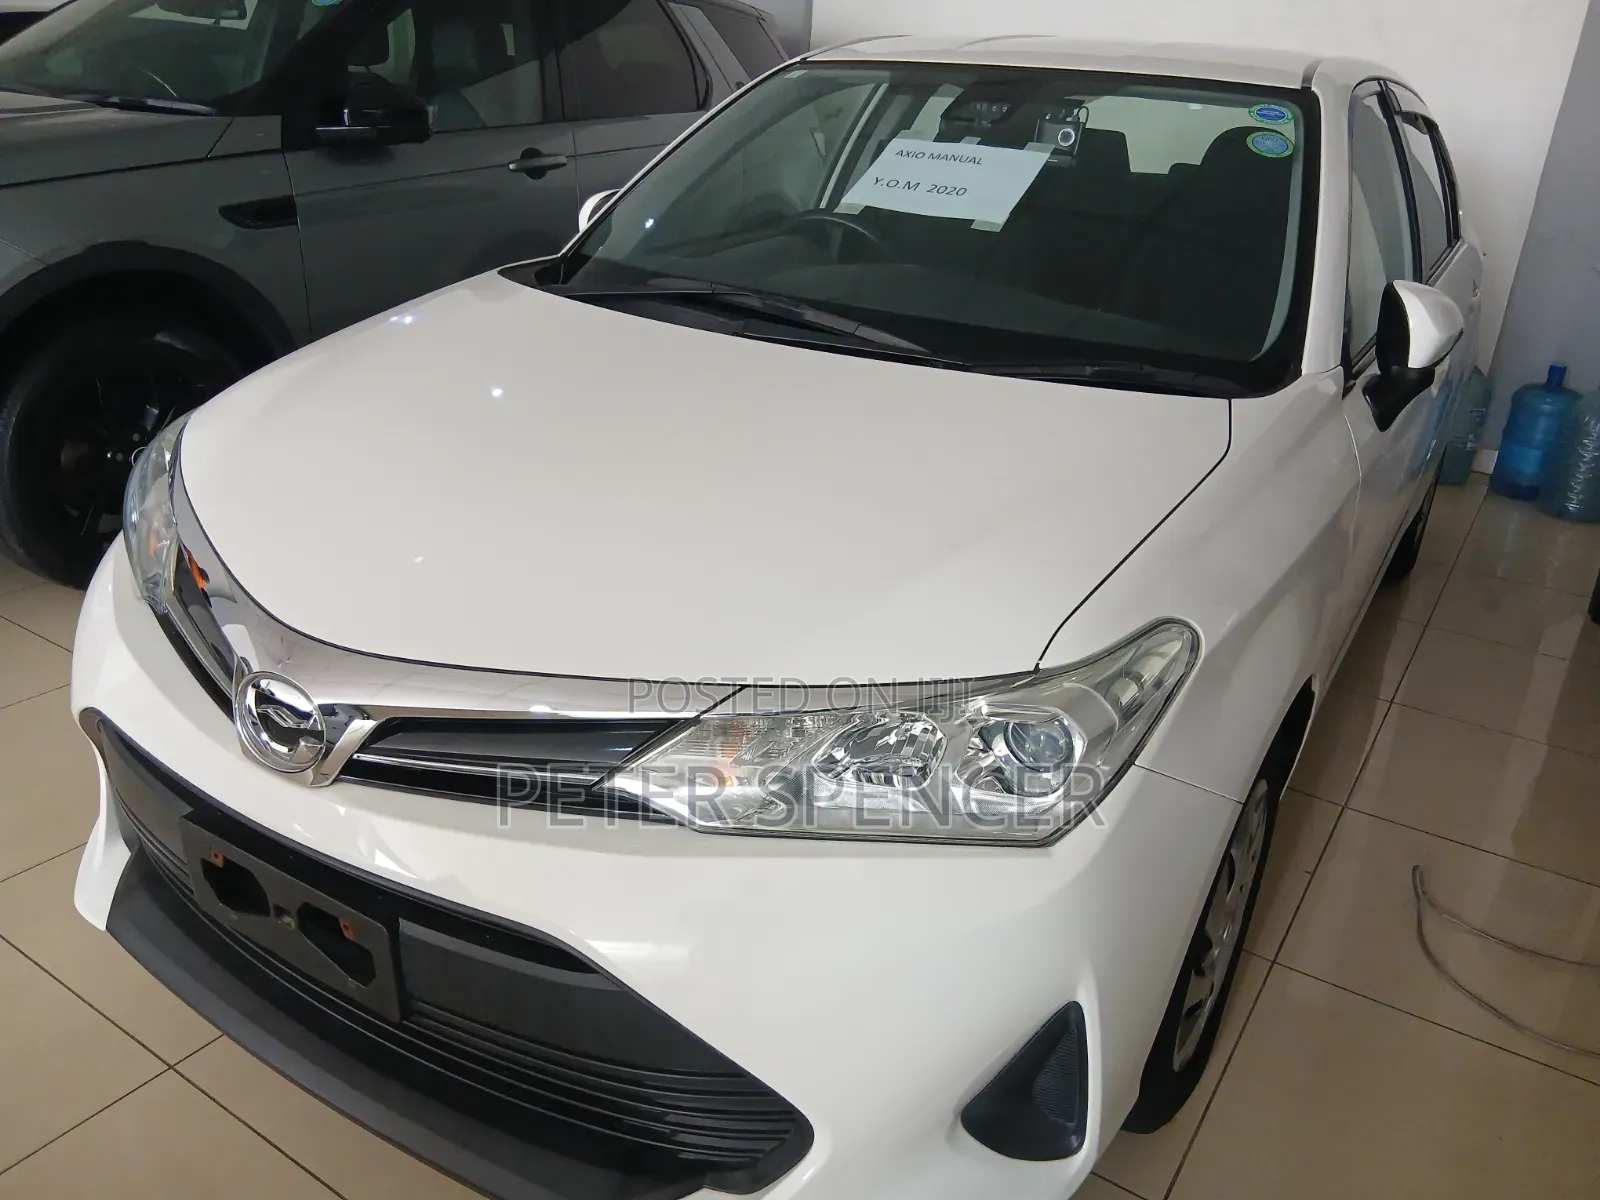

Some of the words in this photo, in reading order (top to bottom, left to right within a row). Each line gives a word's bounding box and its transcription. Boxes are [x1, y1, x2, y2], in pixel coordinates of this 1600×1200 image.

[895, 149, 926, 160] AXIO
[928, 151, 983, 166] MANUAL
[873, 176, 920, 192] Y.O.M
[926, 184, 968, 197] 2020
